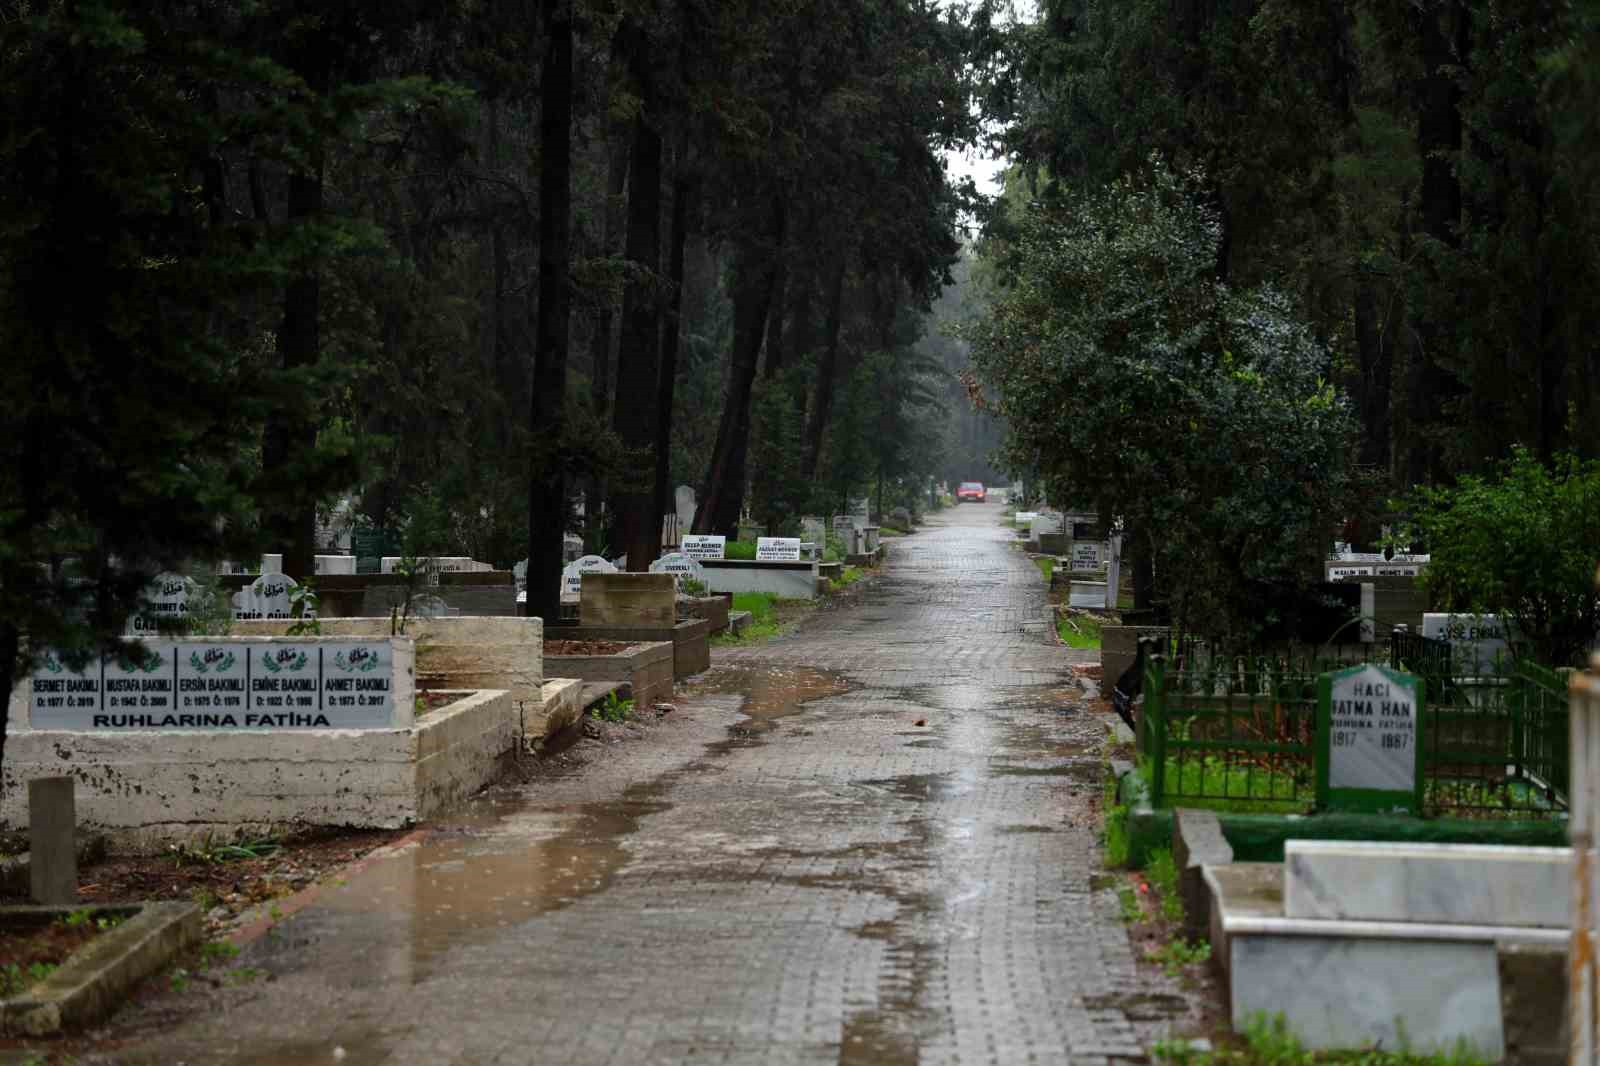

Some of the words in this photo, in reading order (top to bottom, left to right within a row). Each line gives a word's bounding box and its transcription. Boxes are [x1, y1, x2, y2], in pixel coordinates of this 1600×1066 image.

[33, 679, 65, 692] SERMET
[106, 679, 140, 692] MUSTAFA
[180, 677, 206, 692] ERSİN
[252, 676, 280, 691] EMİNE
[325, 678, 354, 691] AHMET
[1353, 683, 1390, 697] HACI
[1331, 700, 1373, 715] FATMA
[1381, 701, 1410, 716] HAN
[93, 714, 238, 727] RUHLARINA
[245, 711, 330, 726] FATİHA
